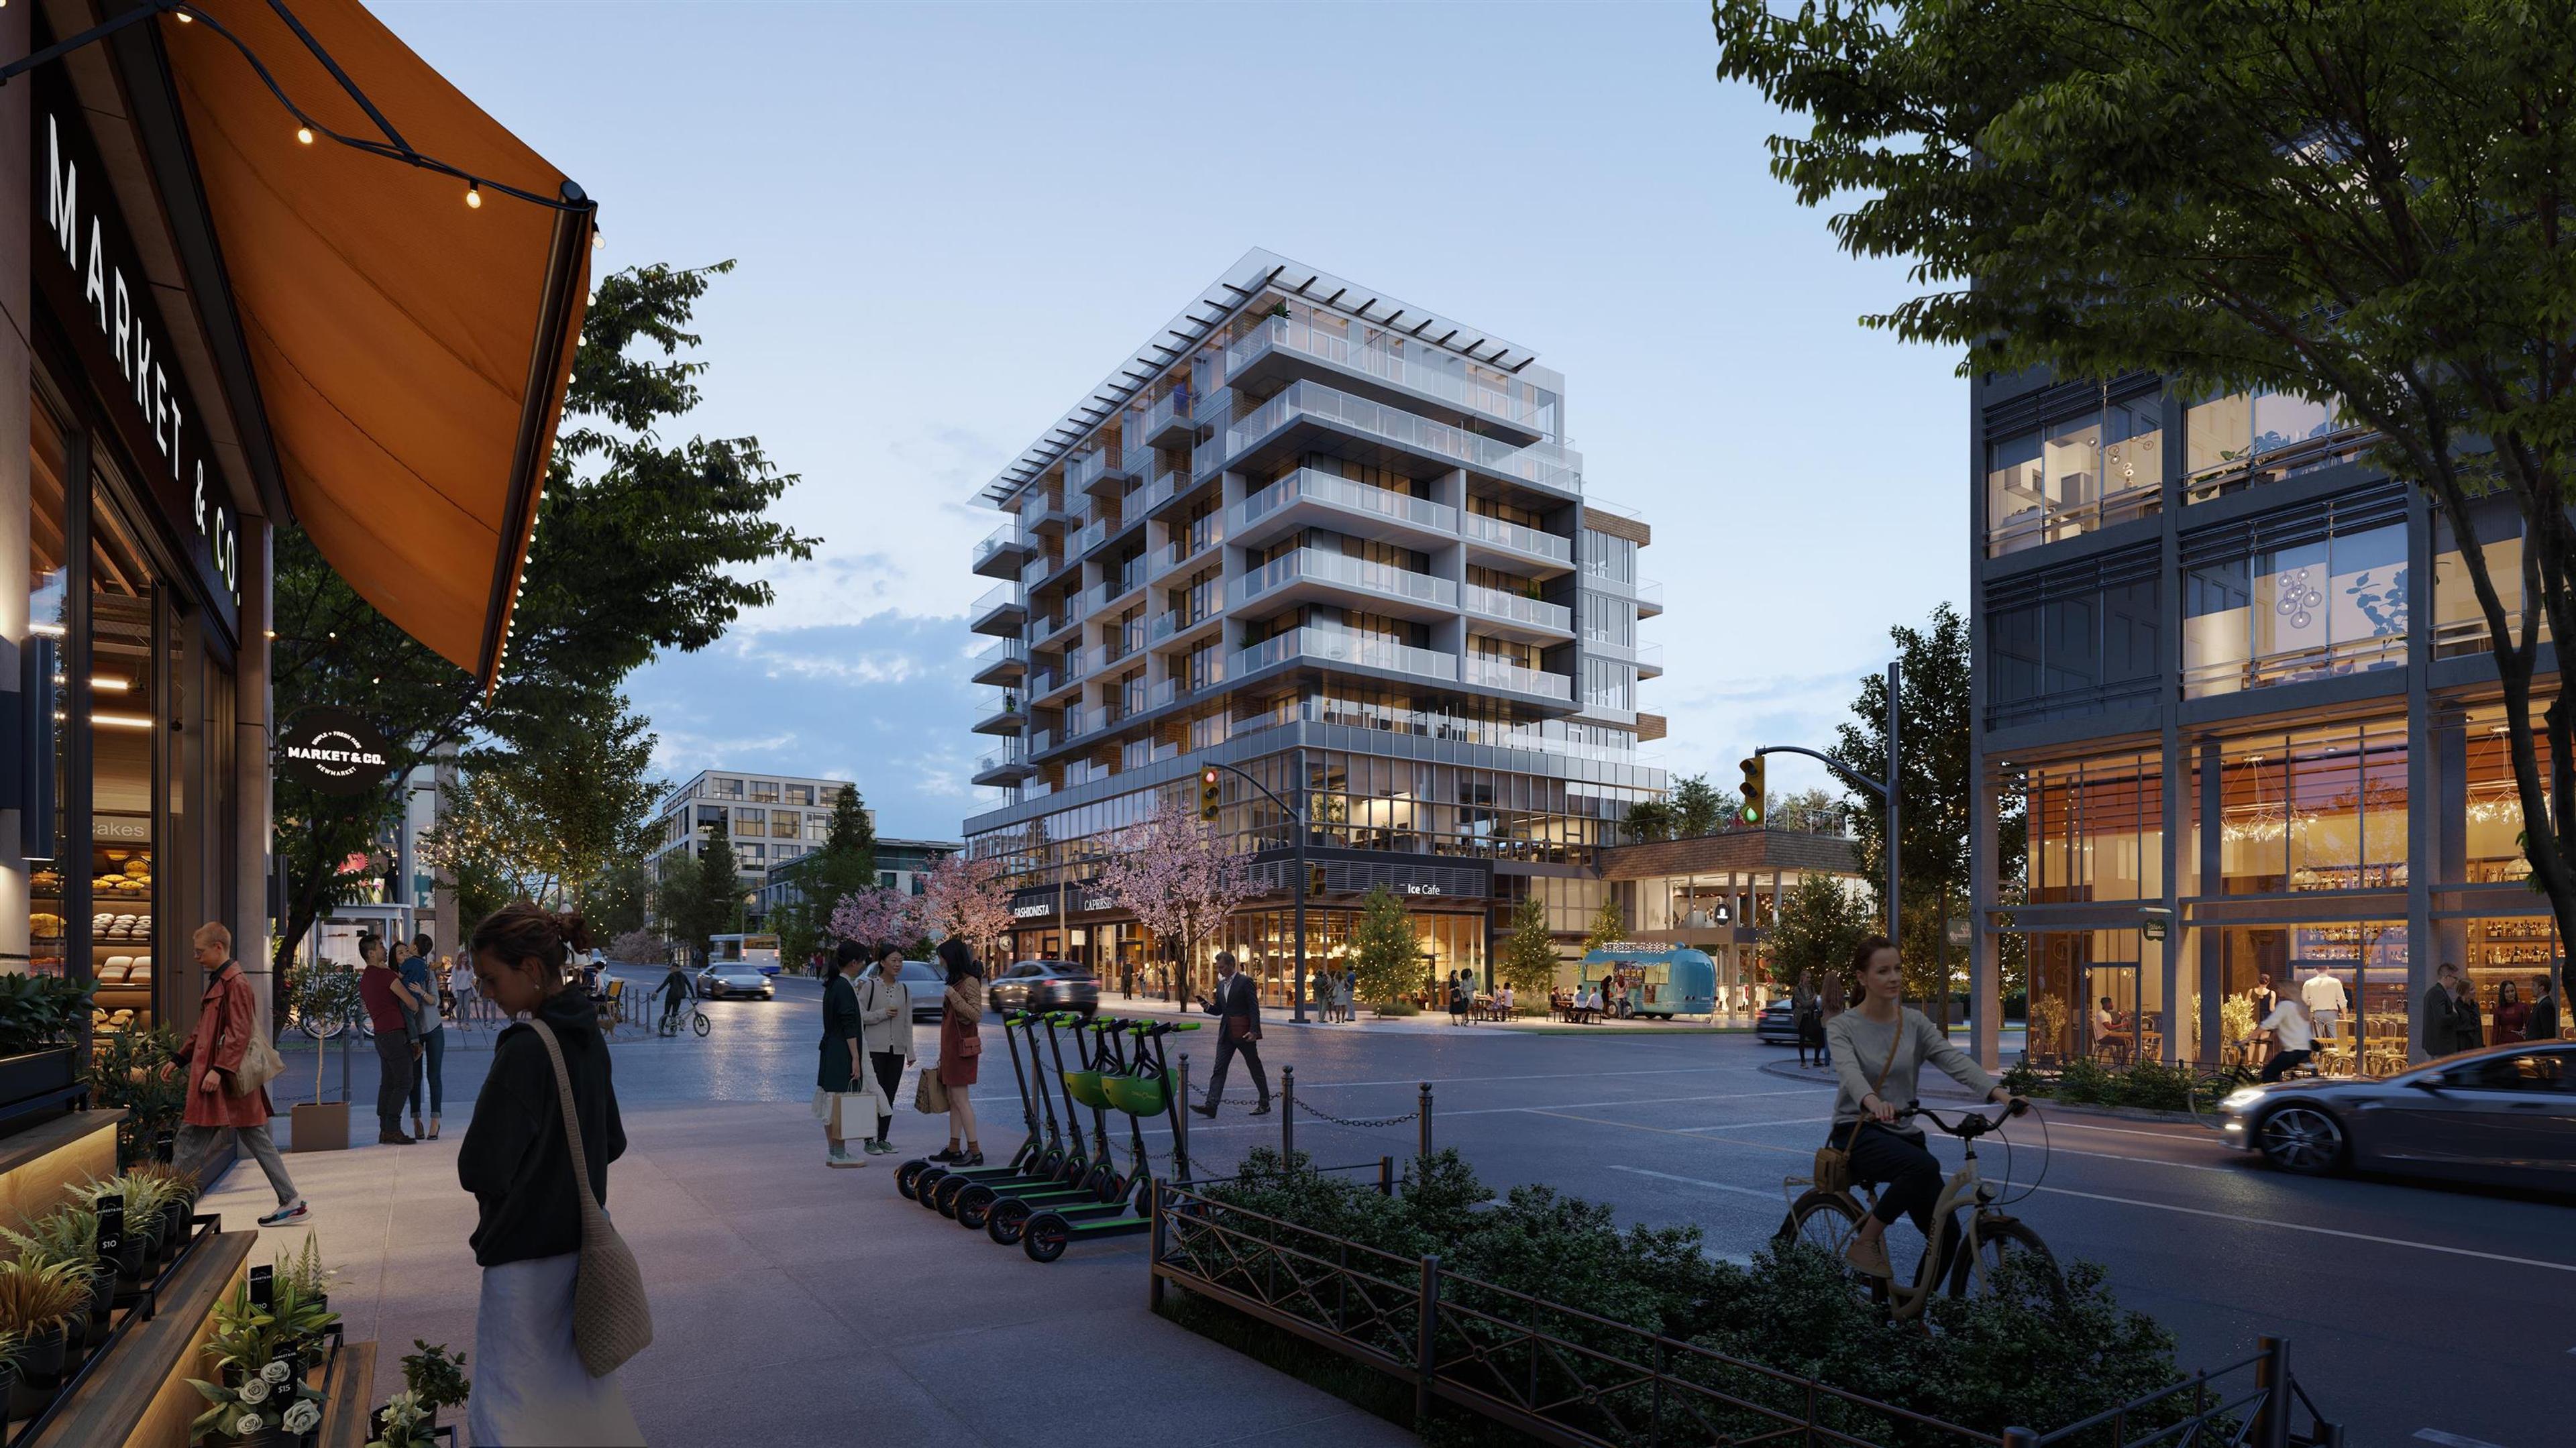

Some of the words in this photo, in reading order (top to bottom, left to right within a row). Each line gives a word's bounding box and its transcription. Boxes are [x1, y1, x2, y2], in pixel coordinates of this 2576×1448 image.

[50, 113, 181, 481] MARKET
[195, 459, 205, 536] &
[216, 506, 240, 606] CO.
[316, 763, 357, 777] NEWMARKET
[93, 822, 144, 837] akes
[1407, 884, 1421, 894] Ice
[1422, 885, 1440, 895] Cafe
[1014, 904, 1050, 918] FASHIONISTA
[1602, 942, 1637, 952] STREET
[103, 1239, 117, 1249] $10
[278, 1384, 290, 1394] $15
